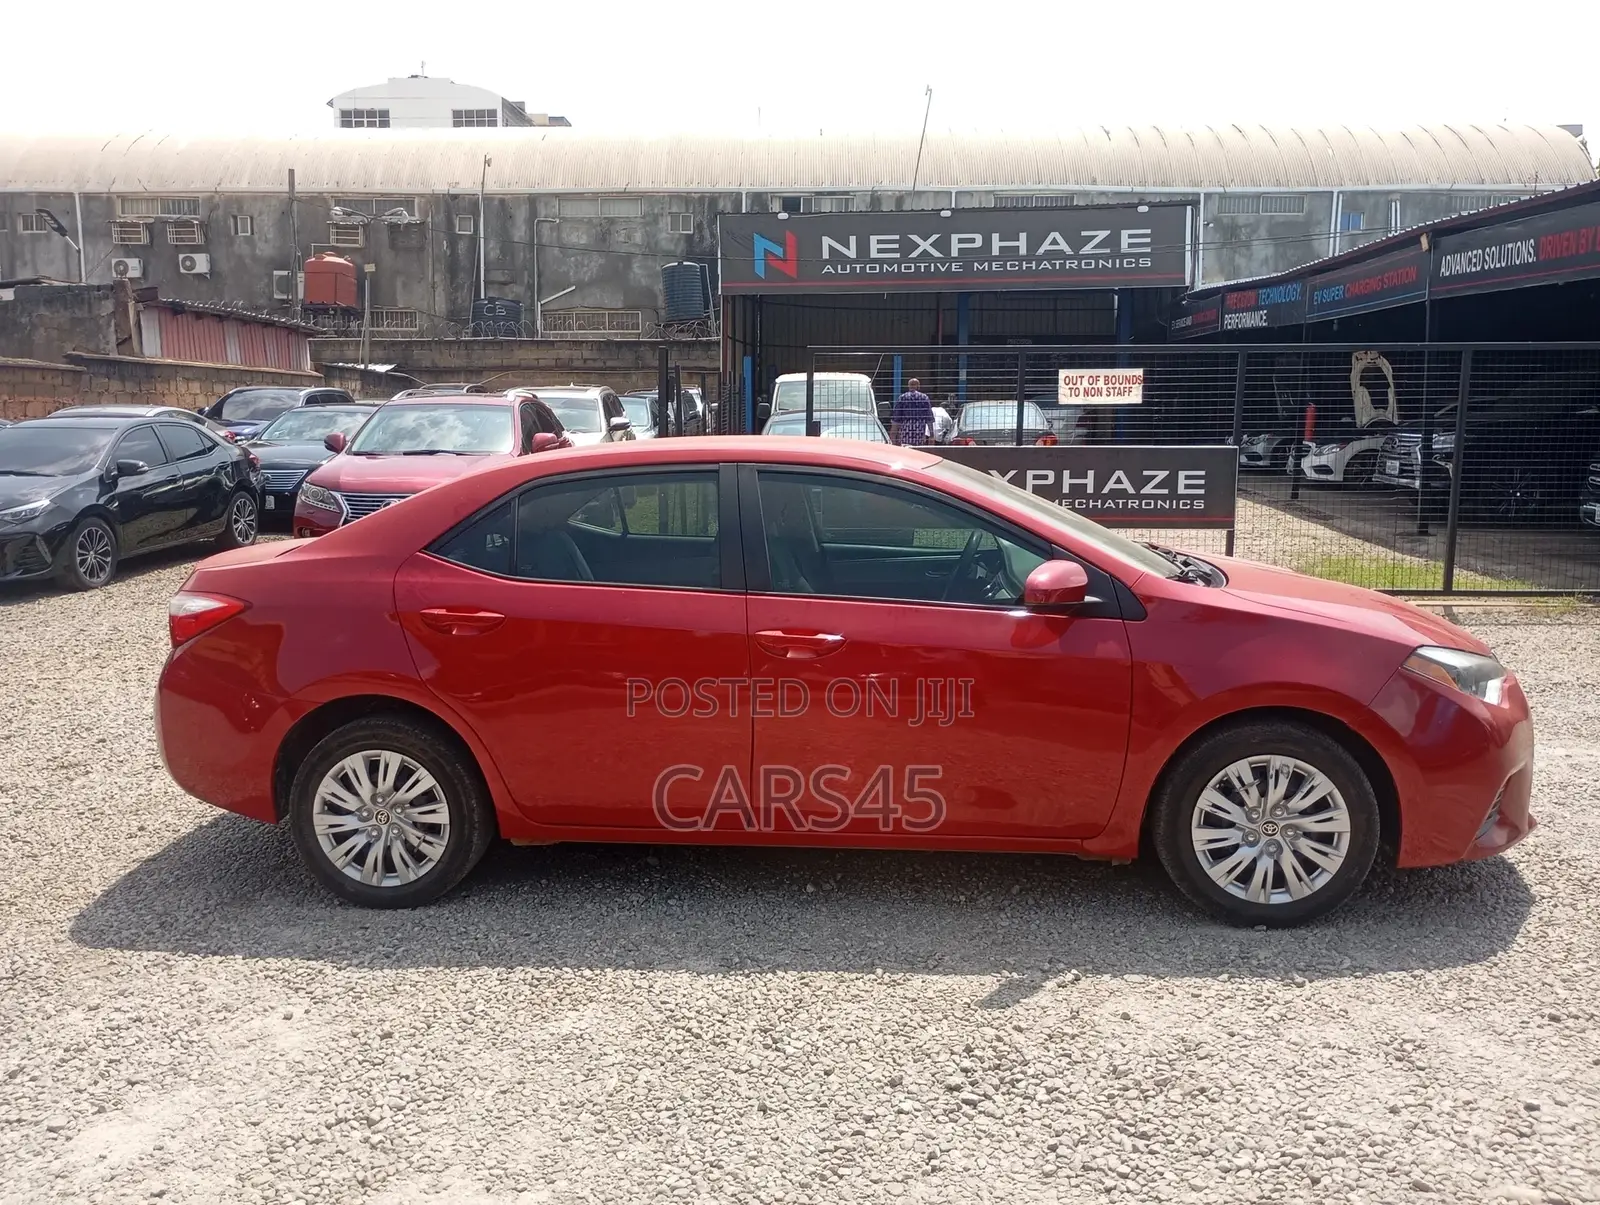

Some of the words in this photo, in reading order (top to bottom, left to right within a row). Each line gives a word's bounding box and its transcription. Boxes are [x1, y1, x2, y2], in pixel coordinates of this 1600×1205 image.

[822, 228, 1151, 259] NEXPHAZE
[1440, 249, 1482, 277] ADVANCED
[1484, 238, 1537, 270] SOLUTIONS.
[1539, 231, 1576, 261] DRIVEN
[1579, 226, 1595, 254] BY
[821, 262, 964, 274] AUTOMOTIVE
[973, 257, 1152, 272] MECHATRONICS
[1313, 291, 1322, 305] EV
[1322, 285, 1344, 303] SUPER
[1344, 275, 1382, 299] CHARGING
[1383, 266, 1417, 288] STATION
[484, 304, 507, 316] CB
[1063, 375, 1084, 386] OUT
[1087, 375, 1101, 386] OF
[1103, 374, 1144, 386] BOUNDS
[1068, 387, 1081, 397] TO
[1083, 386, 1103, 397] NON
[1105, 386, 1133, 397] STAFF
